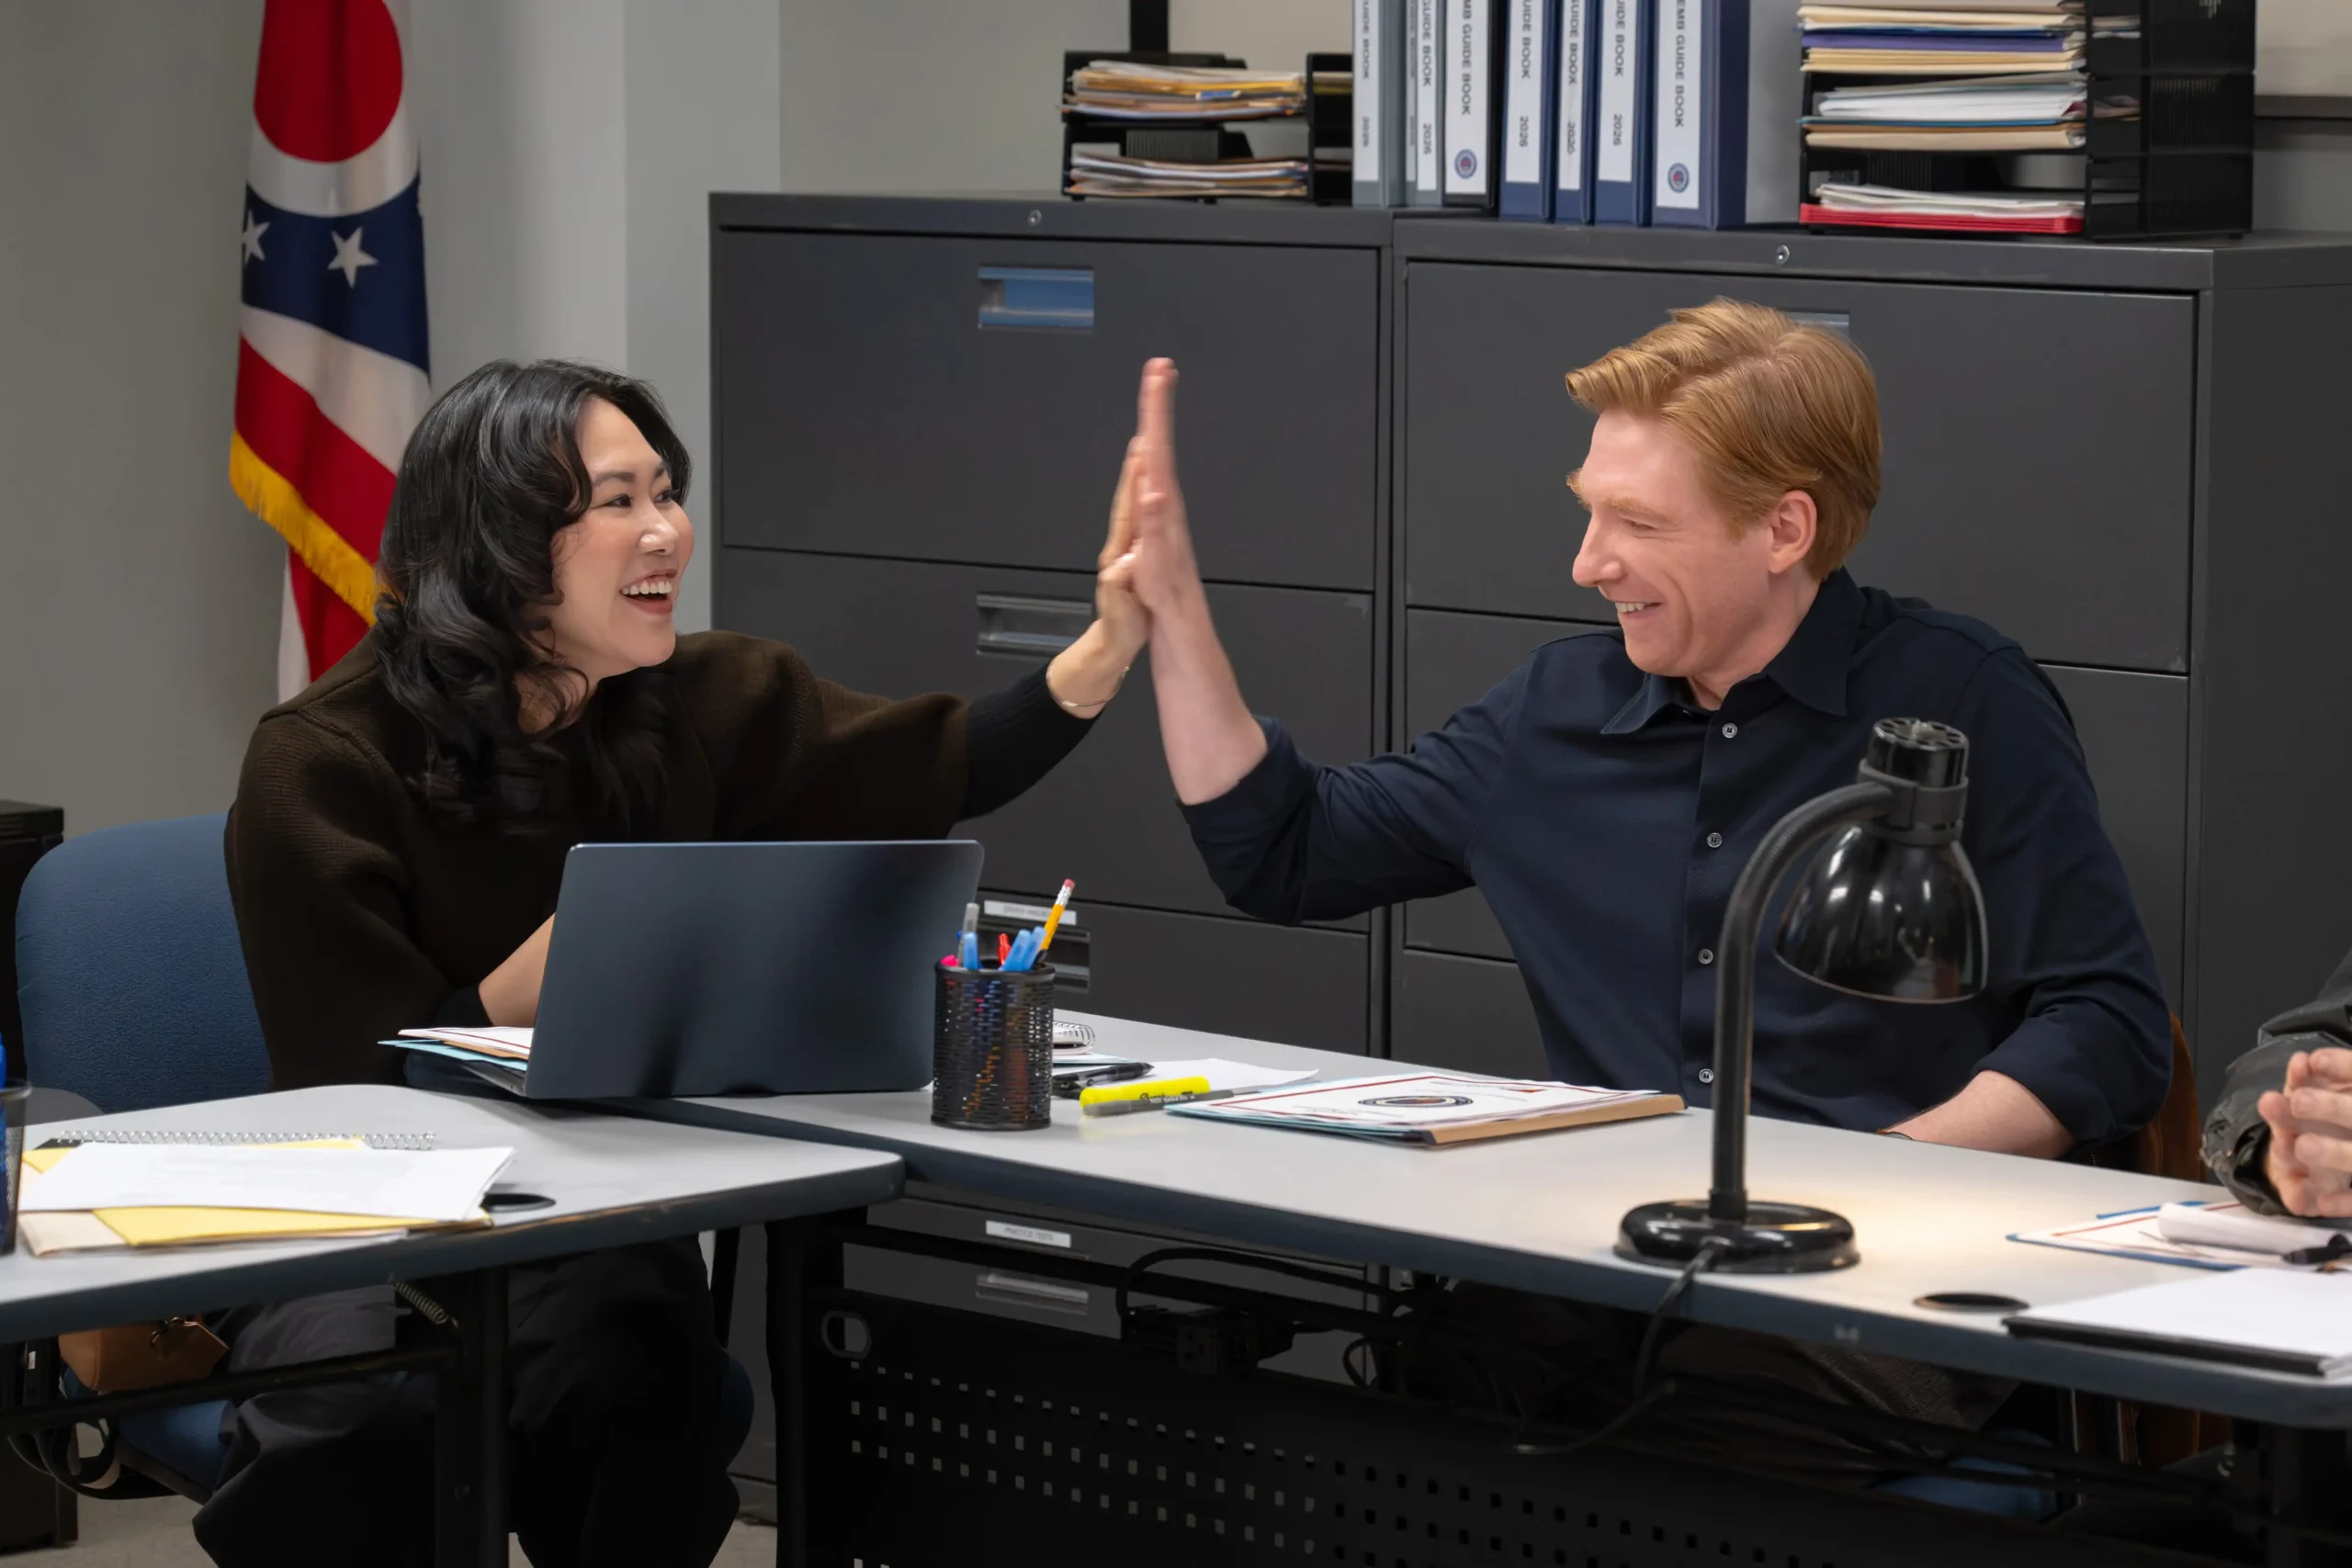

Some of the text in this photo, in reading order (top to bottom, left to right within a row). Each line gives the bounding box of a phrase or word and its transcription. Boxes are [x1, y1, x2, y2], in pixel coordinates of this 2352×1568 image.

[1362, 0, 1371, 34] UIDE
[1421, 45, 1432, 87] BOOK
[1461, 0, 1473, 116] MB GUIDE BOOK
[1519, 0, 1532, 148] UIDE BOOK 2026
[1567, 42, 1578, 85] BOOK
[1614, 34, 1625, 77] BOOK
[1675, 34, 1686, 80] GUIDE
[1674, 85, 1685, 128] BOOK
[1612, 113, 1623, 146] 2026
